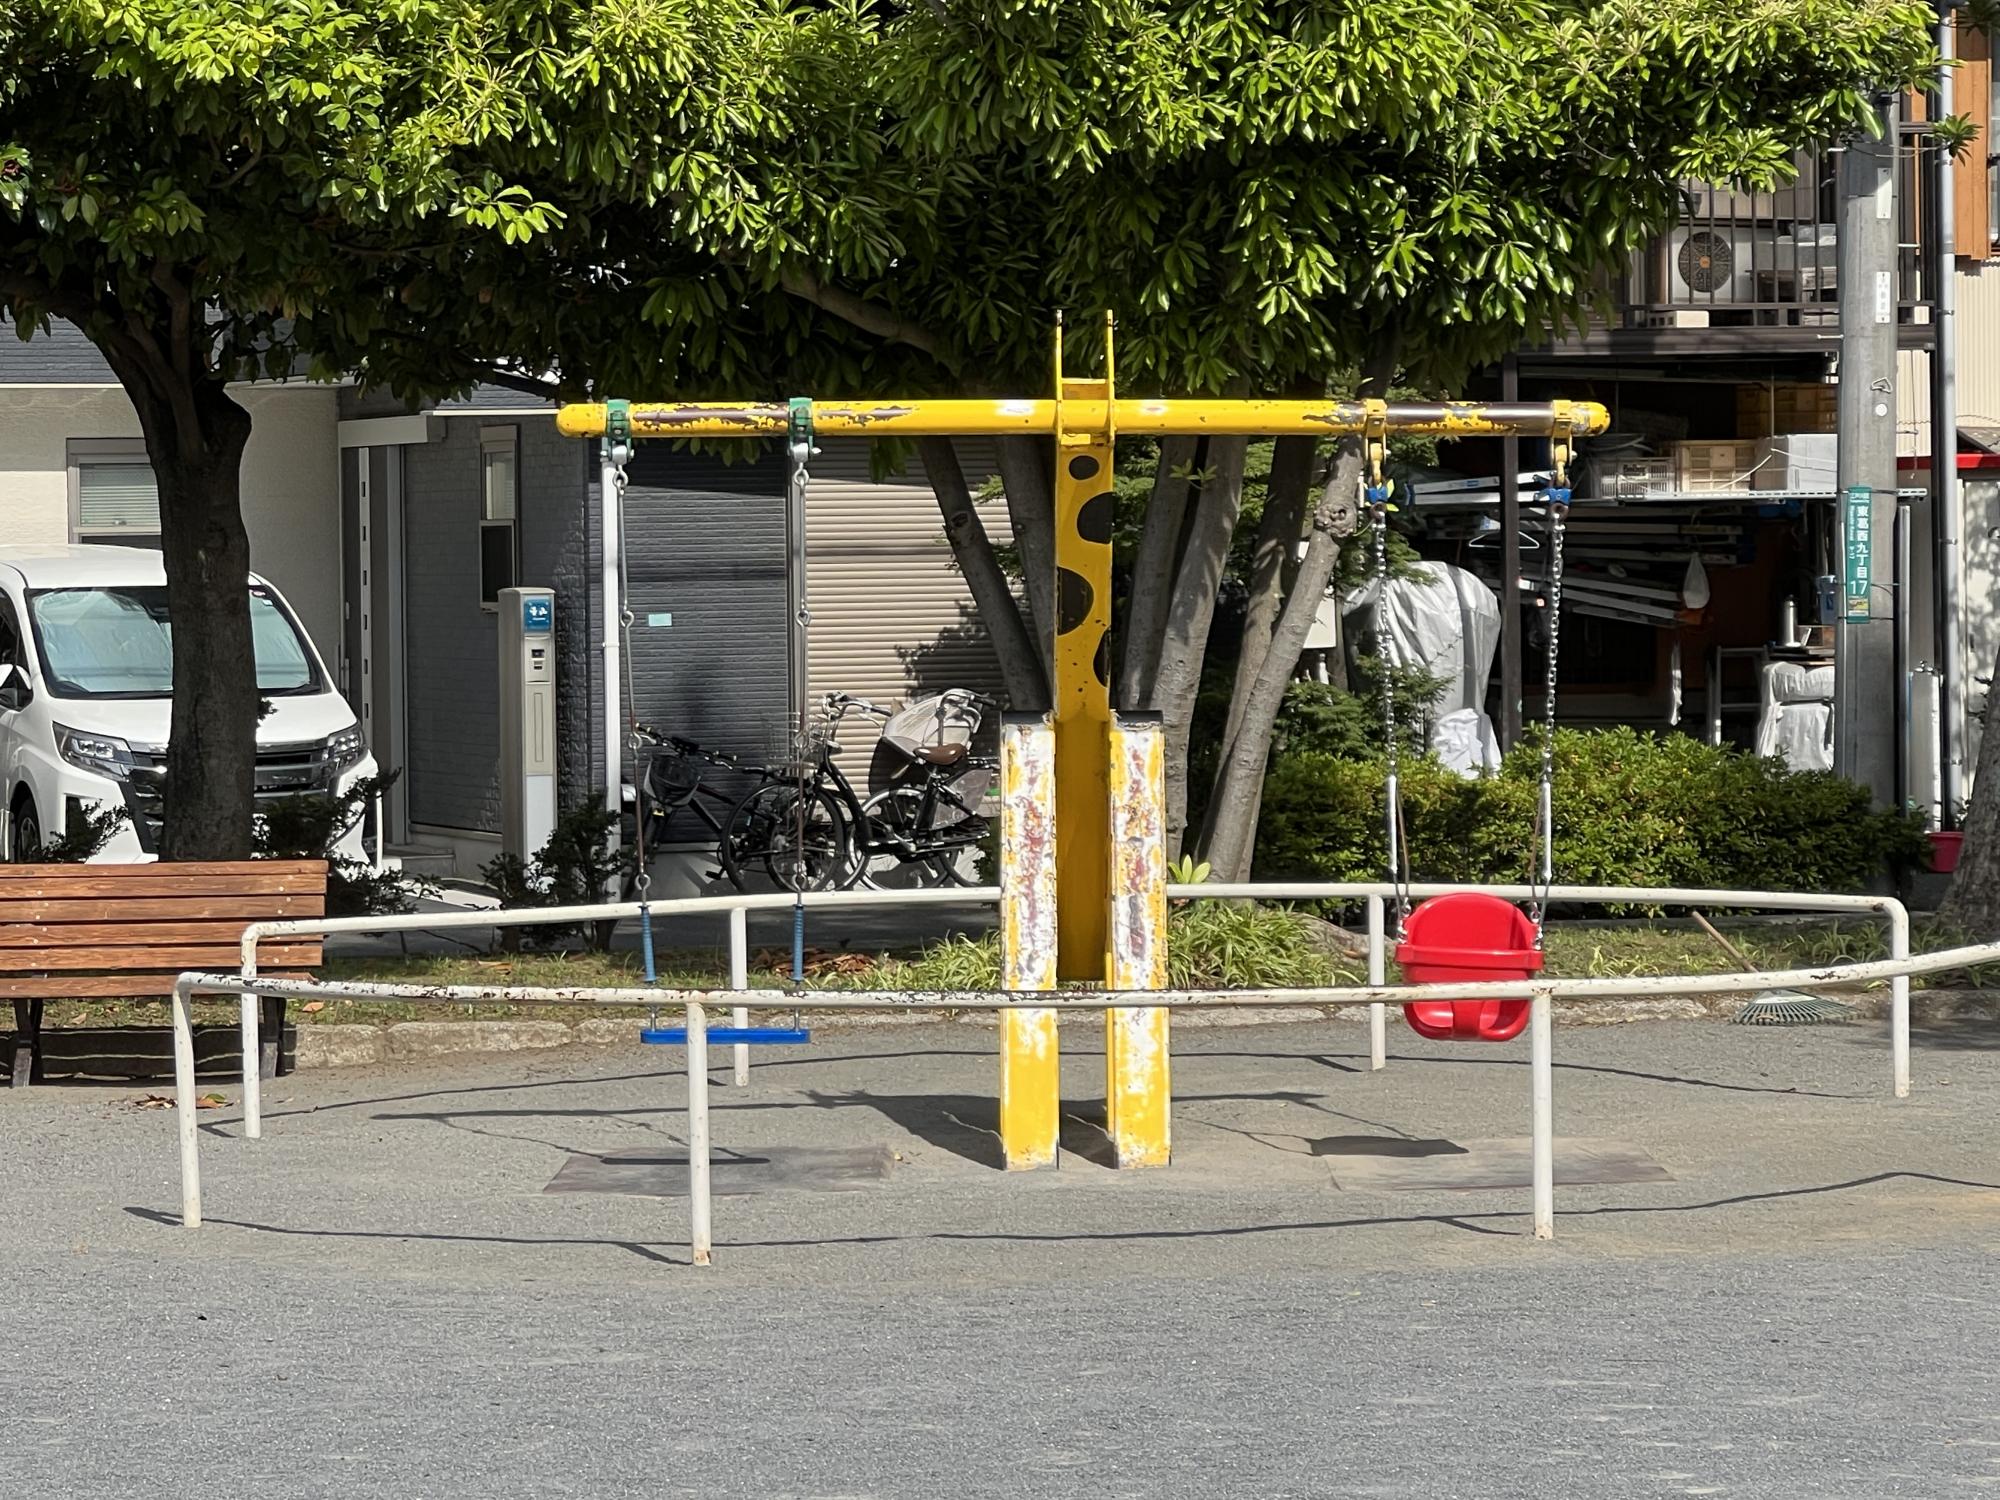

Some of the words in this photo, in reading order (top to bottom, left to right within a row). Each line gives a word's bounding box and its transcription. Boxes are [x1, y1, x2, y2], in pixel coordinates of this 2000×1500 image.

[1857, 506, 1869, 579] 東葛西九丁目
[1850, 580, 1868, 595] 17
